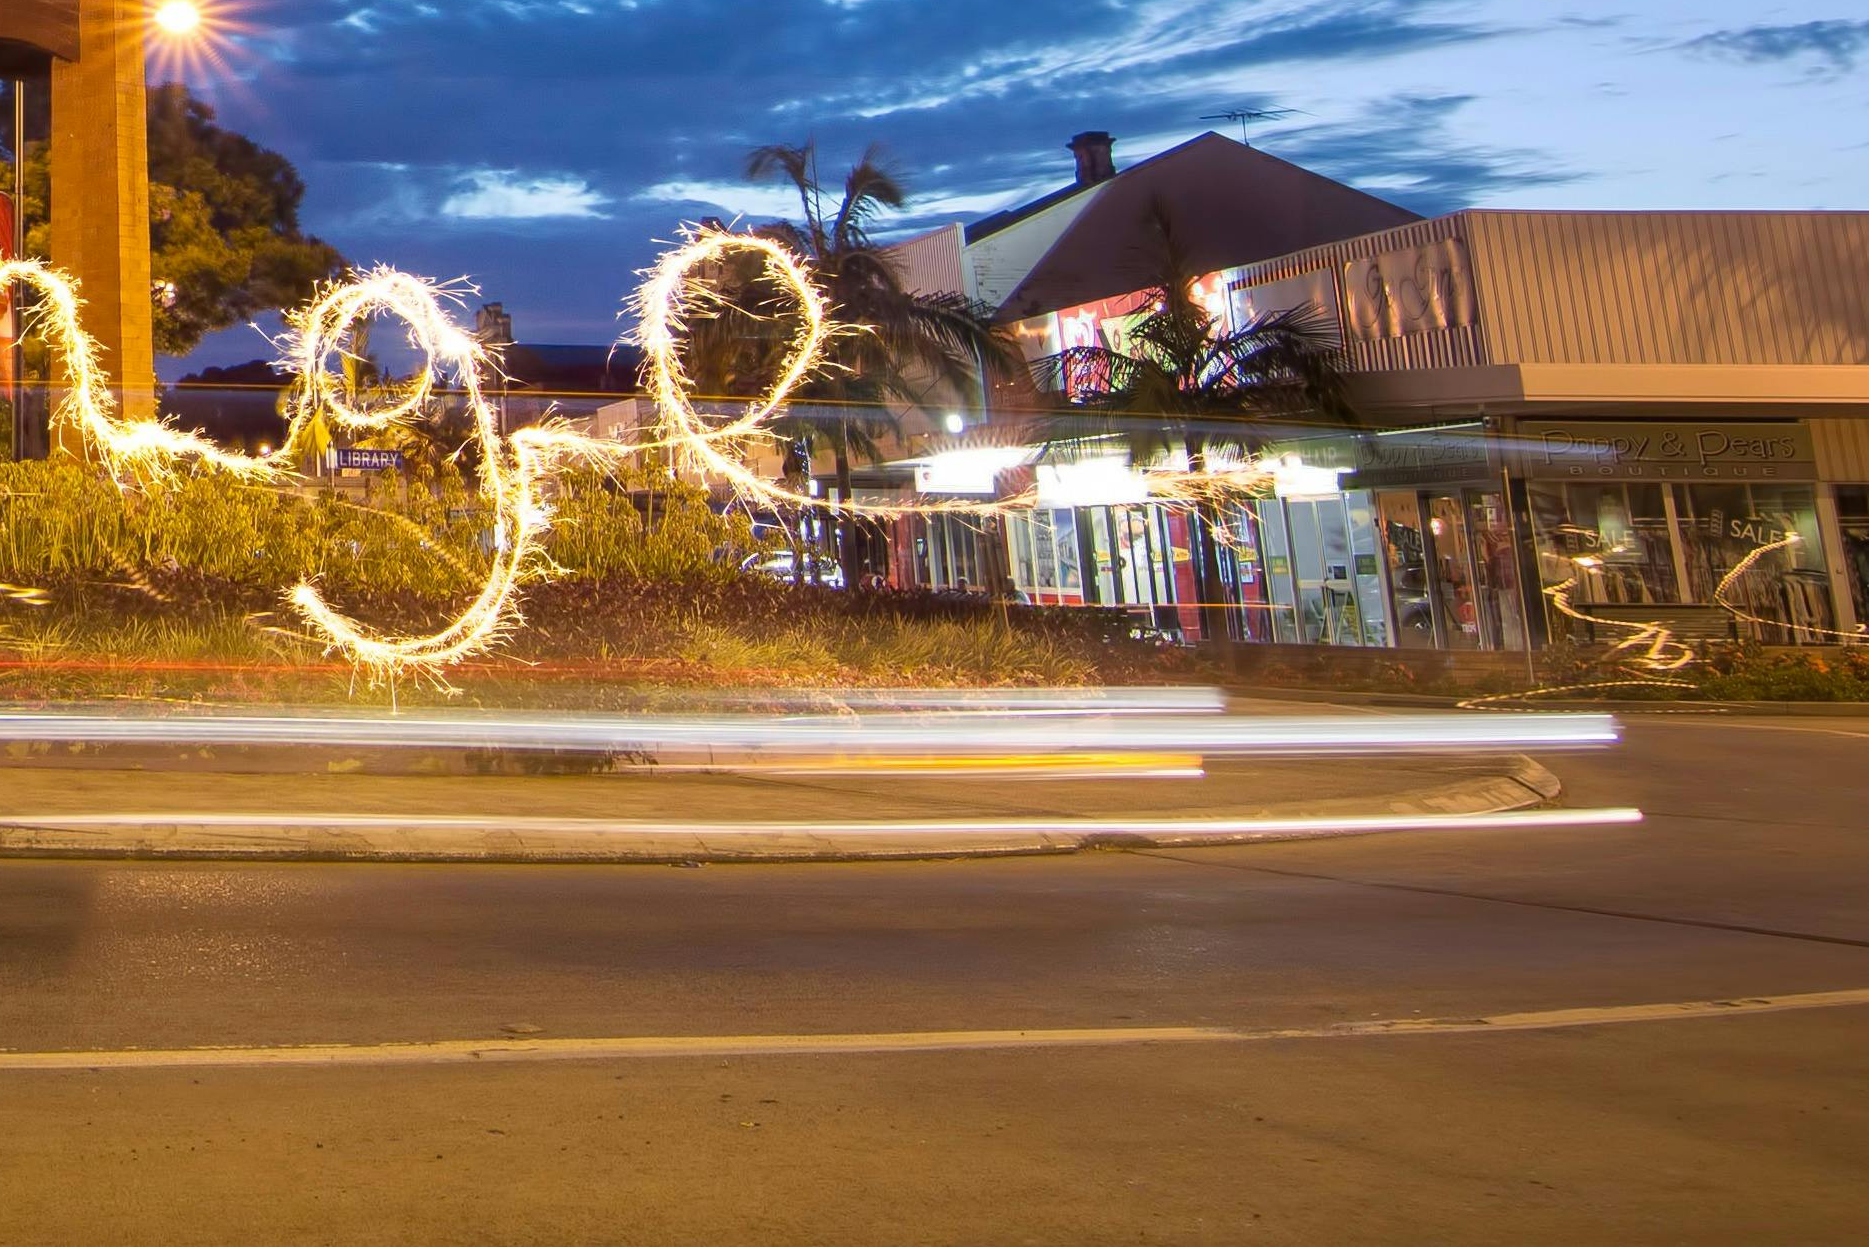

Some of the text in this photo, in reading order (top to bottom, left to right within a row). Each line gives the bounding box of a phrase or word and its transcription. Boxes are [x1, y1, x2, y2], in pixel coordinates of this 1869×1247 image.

[1541, 429, 1797, 466] Poppy & Pears
[338, 450, 399, 468] LIBRARY
[1568, 466, 1779, 477] BOUTIQUE
[1585, 529, 1636, 548] SALE
[1730, 518, 1784, 546] SALE
